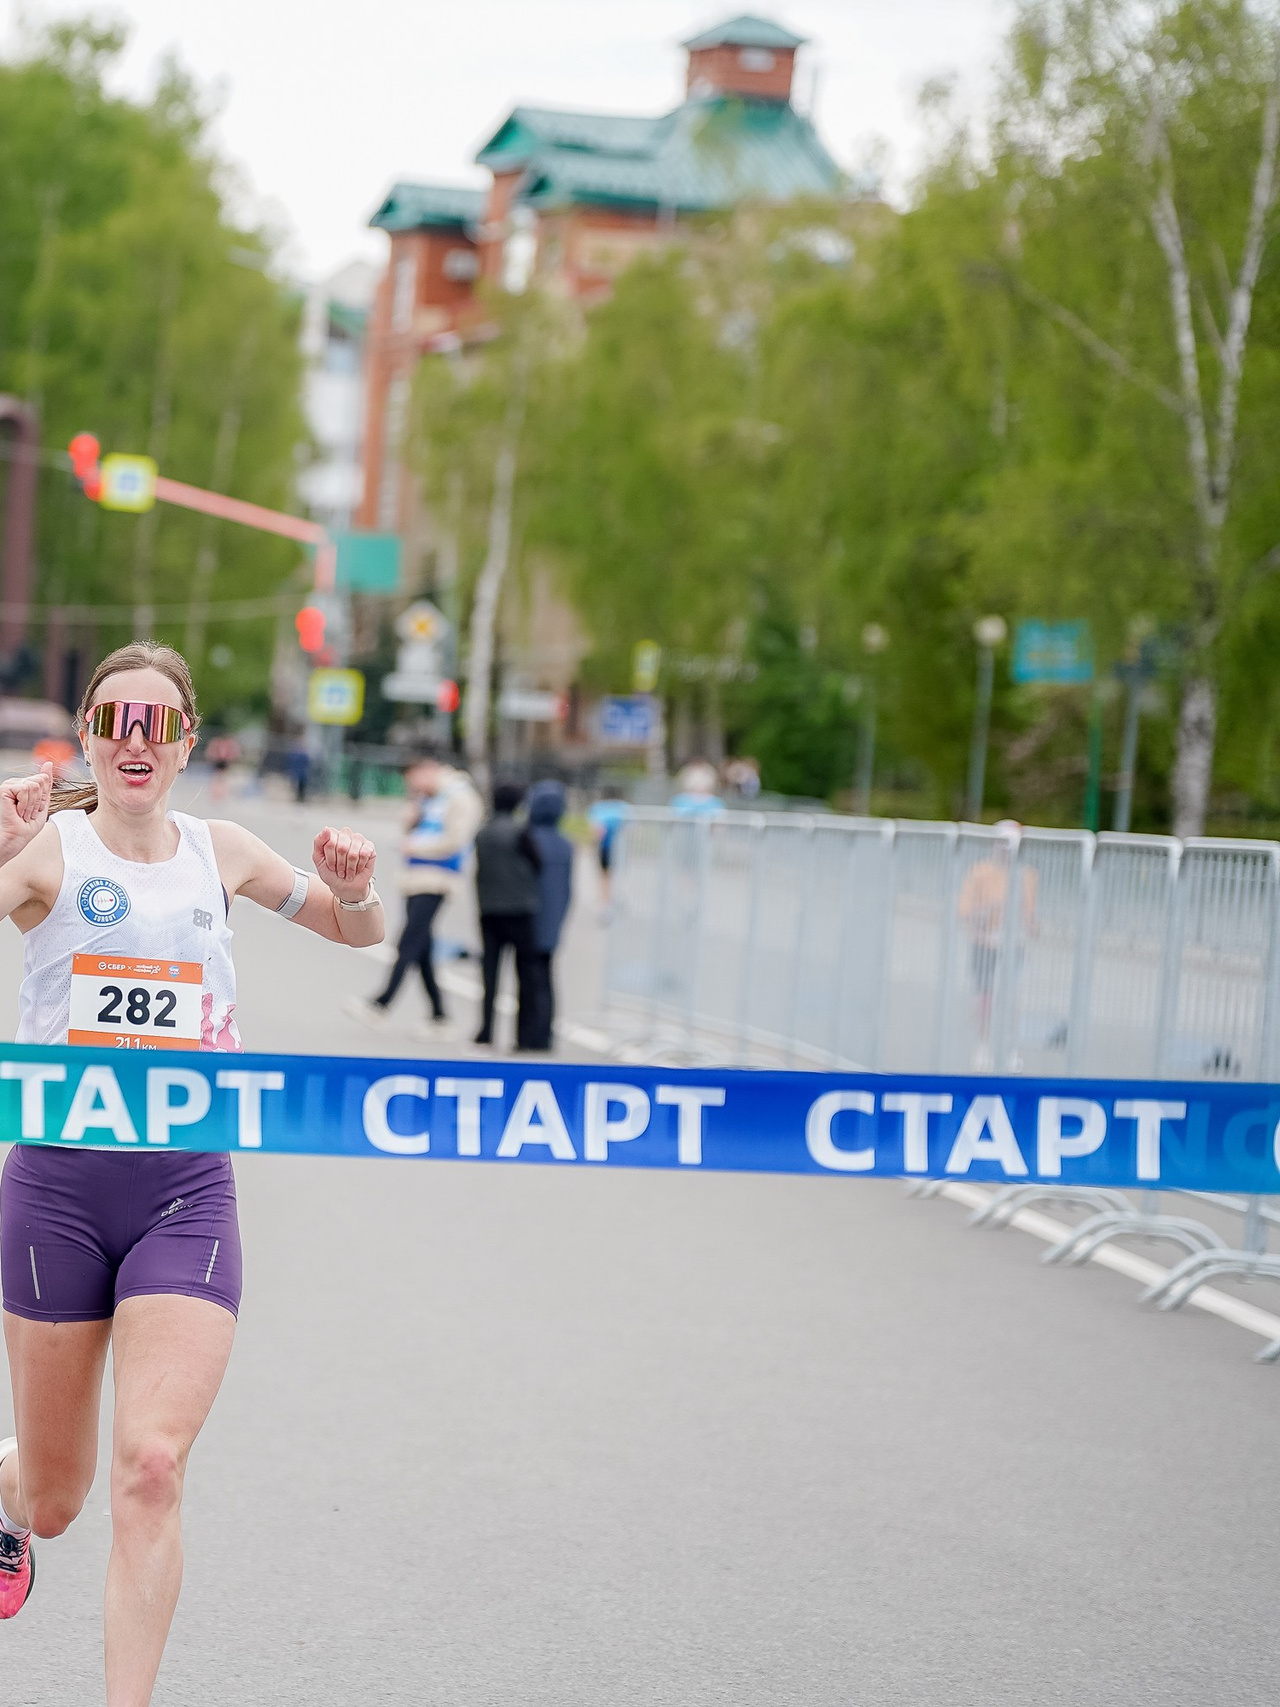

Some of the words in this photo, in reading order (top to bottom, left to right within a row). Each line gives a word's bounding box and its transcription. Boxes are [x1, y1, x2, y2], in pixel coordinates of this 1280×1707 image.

[97, 985, 177, 1028] 282
[363, 1074, 726, 1165] СТАРТ
[806, 1091, 1186, 1180] СТАРТ
